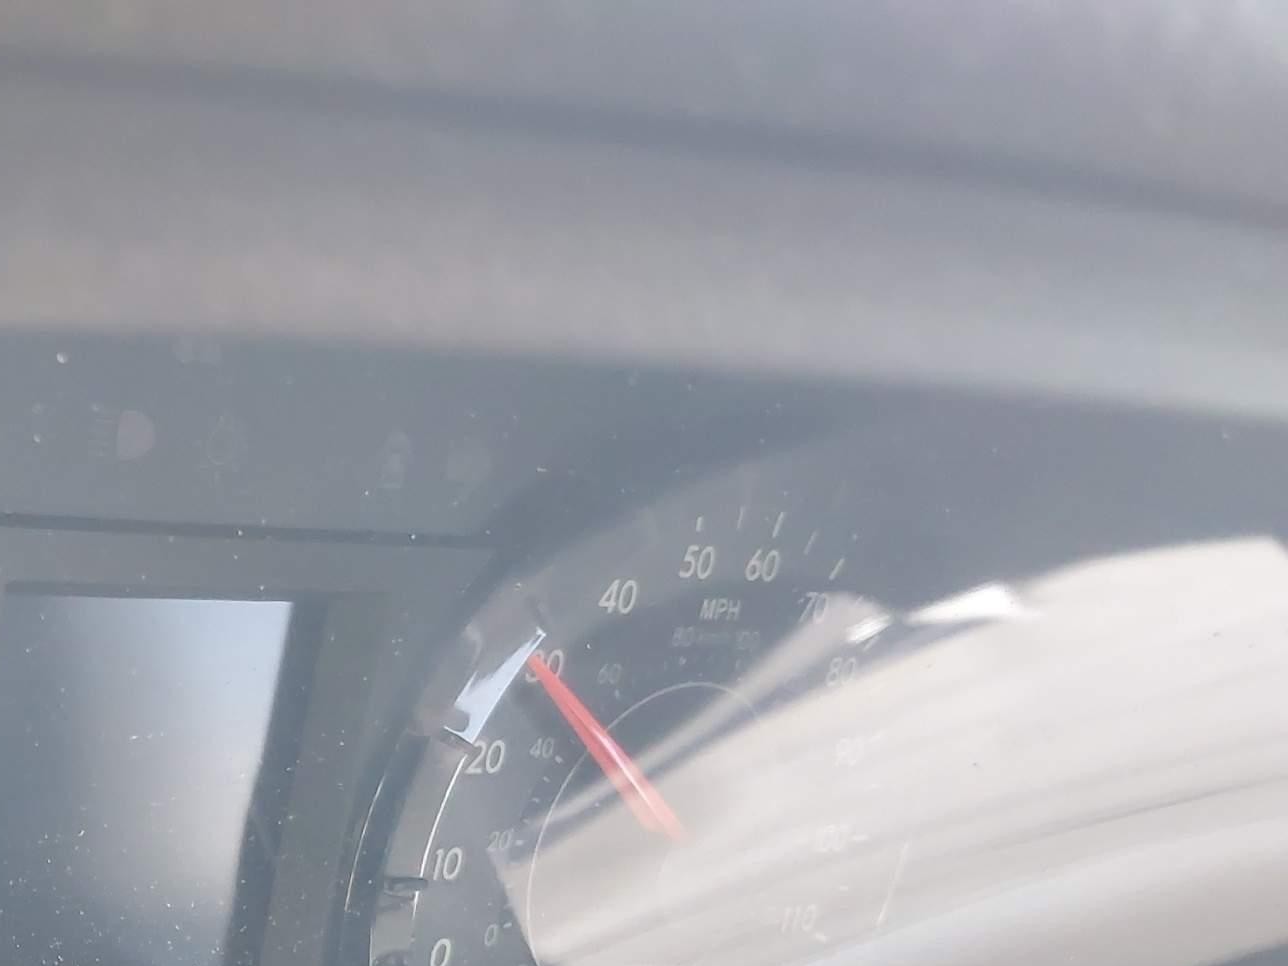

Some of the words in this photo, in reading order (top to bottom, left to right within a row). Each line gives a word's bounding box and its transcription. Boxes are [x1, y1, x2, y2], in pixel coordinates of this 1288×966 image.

[678, 545, 714, 579] 50
[744, 550, 780, 582] 60
[598, 579, 638, 614] 40
[699, 597, 741, 621] MPH
[464, 739, 507, 775] 20
[529, 737, 555, 759] 40
[432, 847, 462, 881] 10
